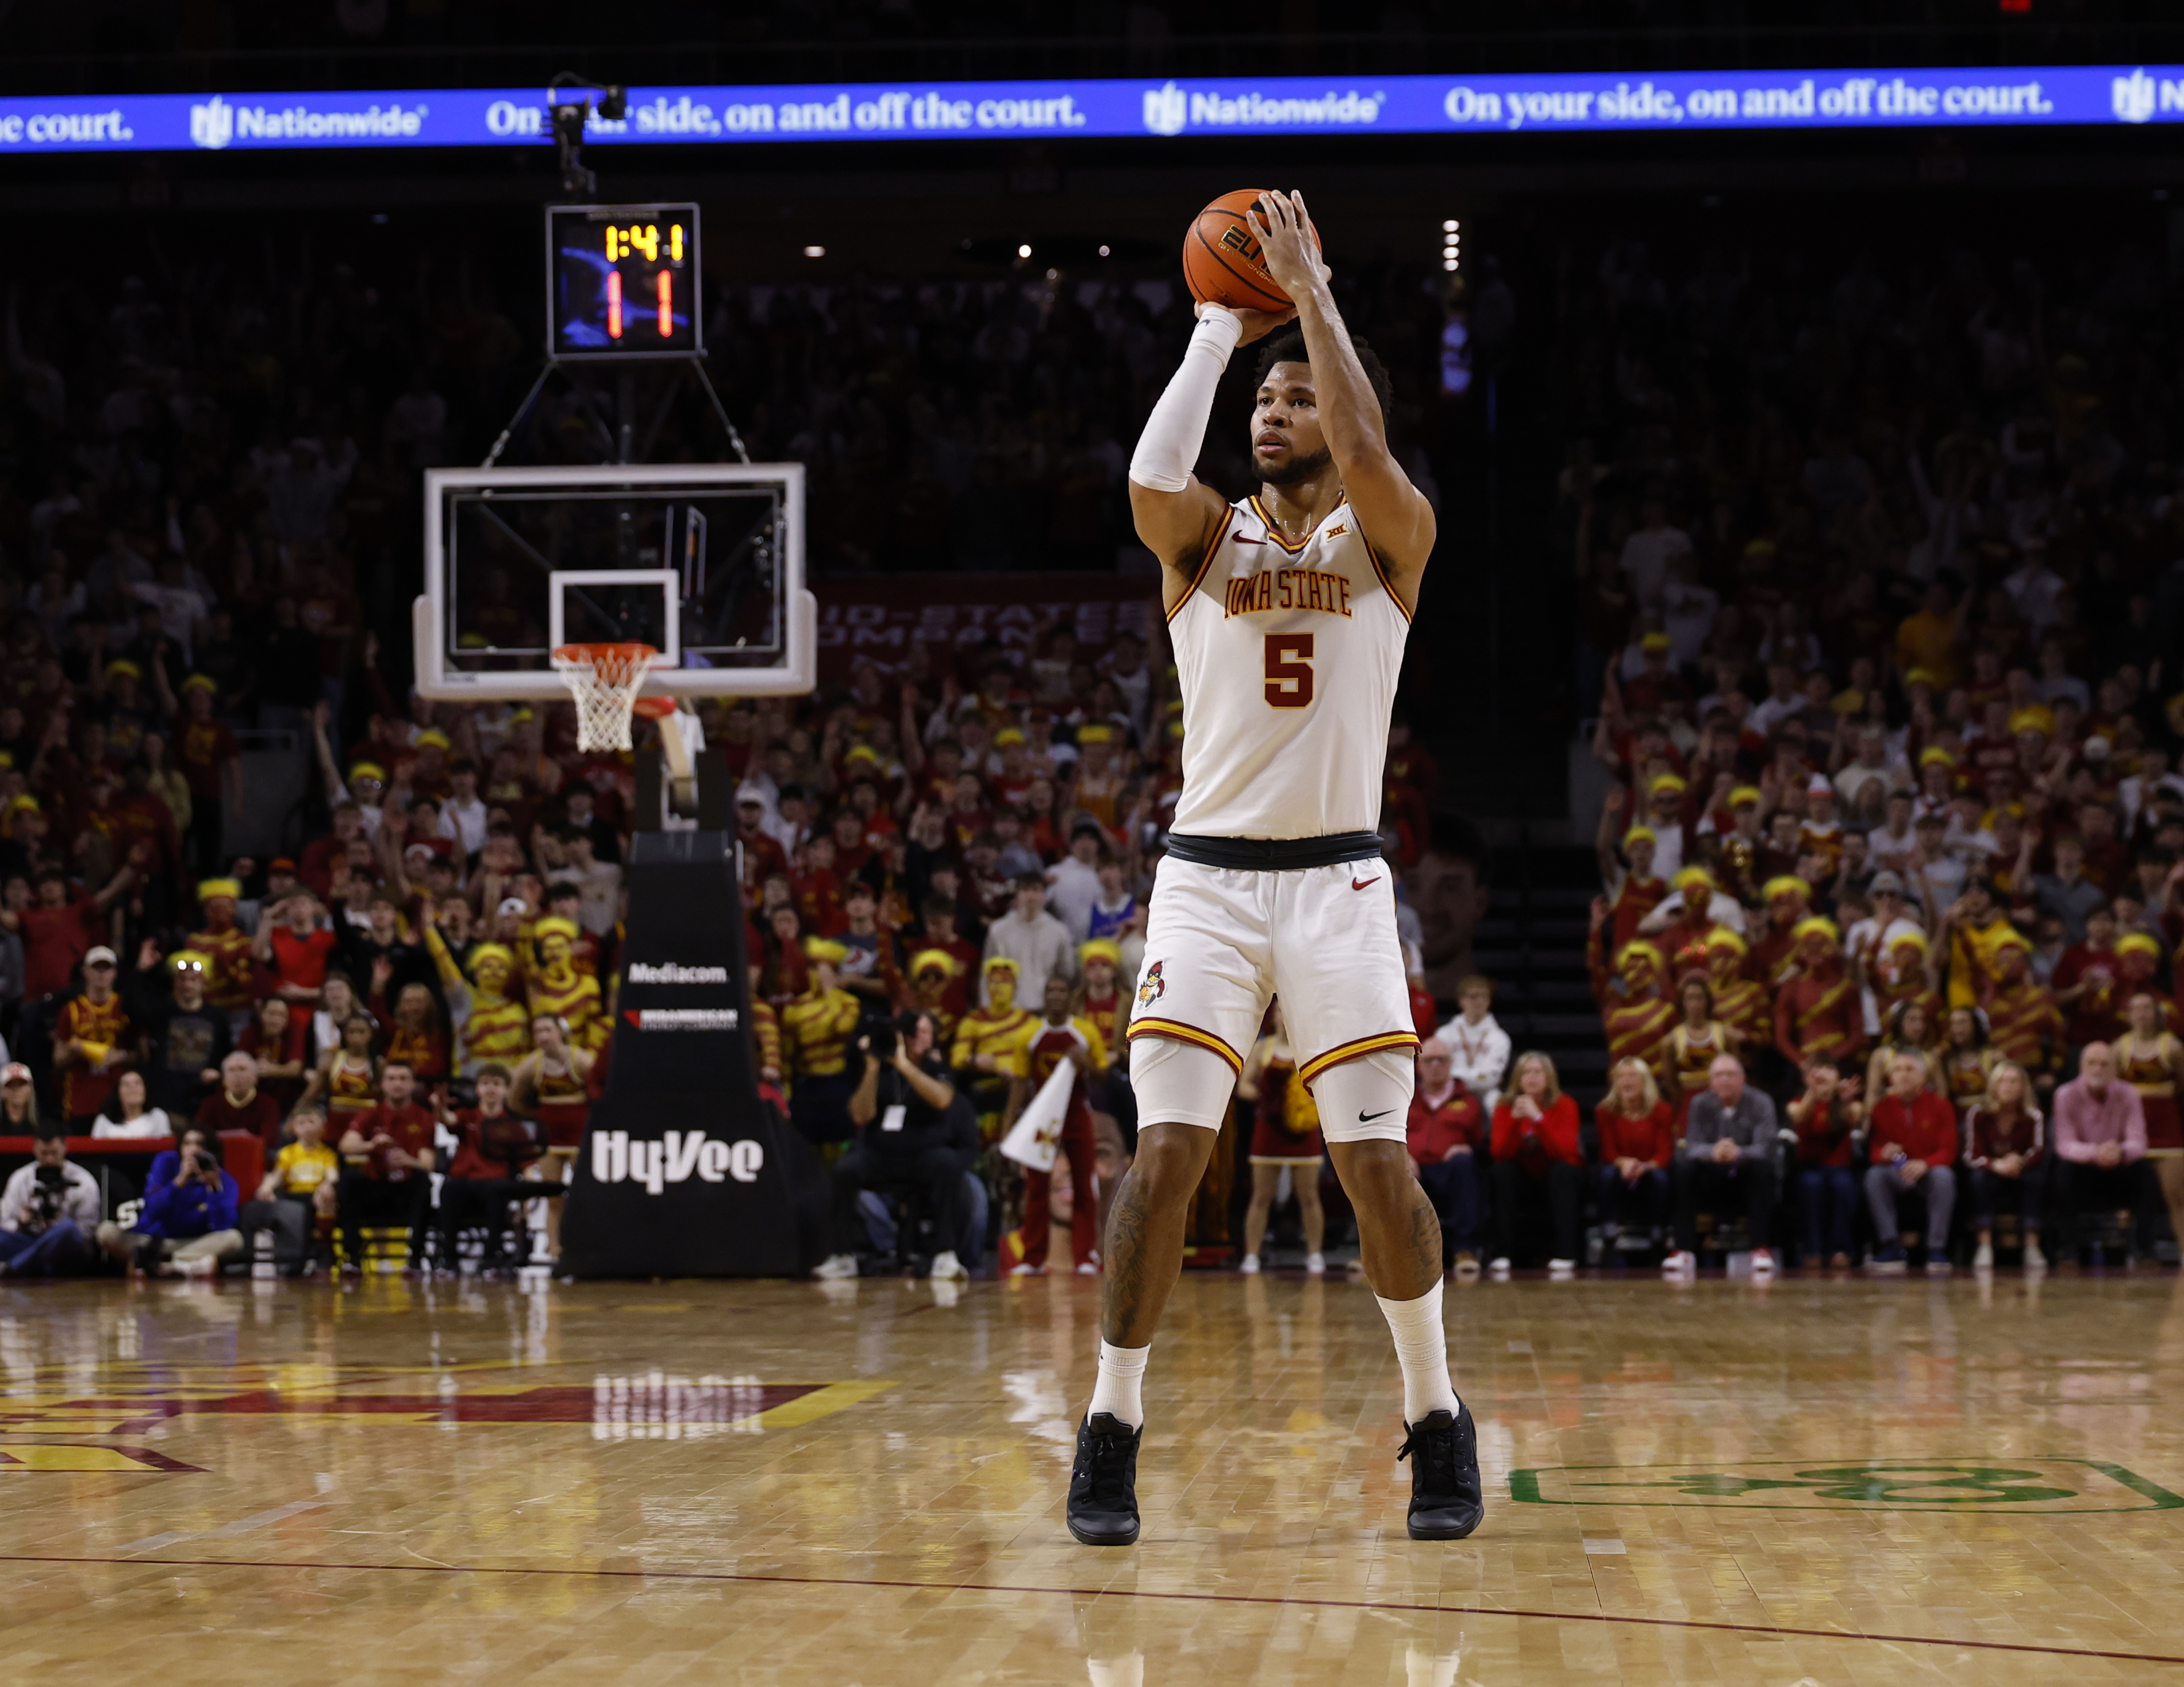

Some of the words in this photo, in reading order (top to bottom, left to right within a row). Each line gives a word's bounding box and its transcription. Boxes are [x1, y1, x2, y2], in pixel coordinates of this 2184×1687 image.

[1190, 92, 1379, 124] Nationwide
[1444, 87, 1502, 121] On
[1506, 92, 1594, 128] your
[1597, 82, 1684, 121] side,
[1686, 90, 1738, 117] on
[1741, 80, 1815, 117] and
[1818, 79, 1877, 115] off
[1877, 79, 1939, 115] the
[1942, 83, 2052, 114] court.
[2159, 79, 2184, 111] N
[26, 110, 133, 142] court.
[237, 106, 422, 138] Nationwide
[486, 102, 541, 134] On
[636, 97, 721, 134] side,
[725, 105, 774, 131] on
[778, 94, 850, 131] and
[854, 93, 912, 129] off
[912, 92, 972, 129] the
[975, 95, 1085, 128] court.
[606, 224, 683, 262] 1:41
[1221, 224, 1272, 277] ELI
[607, 269, 673, 338] 11
[1325, 521, 1348, 540] XII
[1224, 569, 1274, 621] IOWA
[1277, 569, 1352, 619] STATE
[1264, 633, 1314, 709] 5
[628, 962, 728, 983] Mediacom
